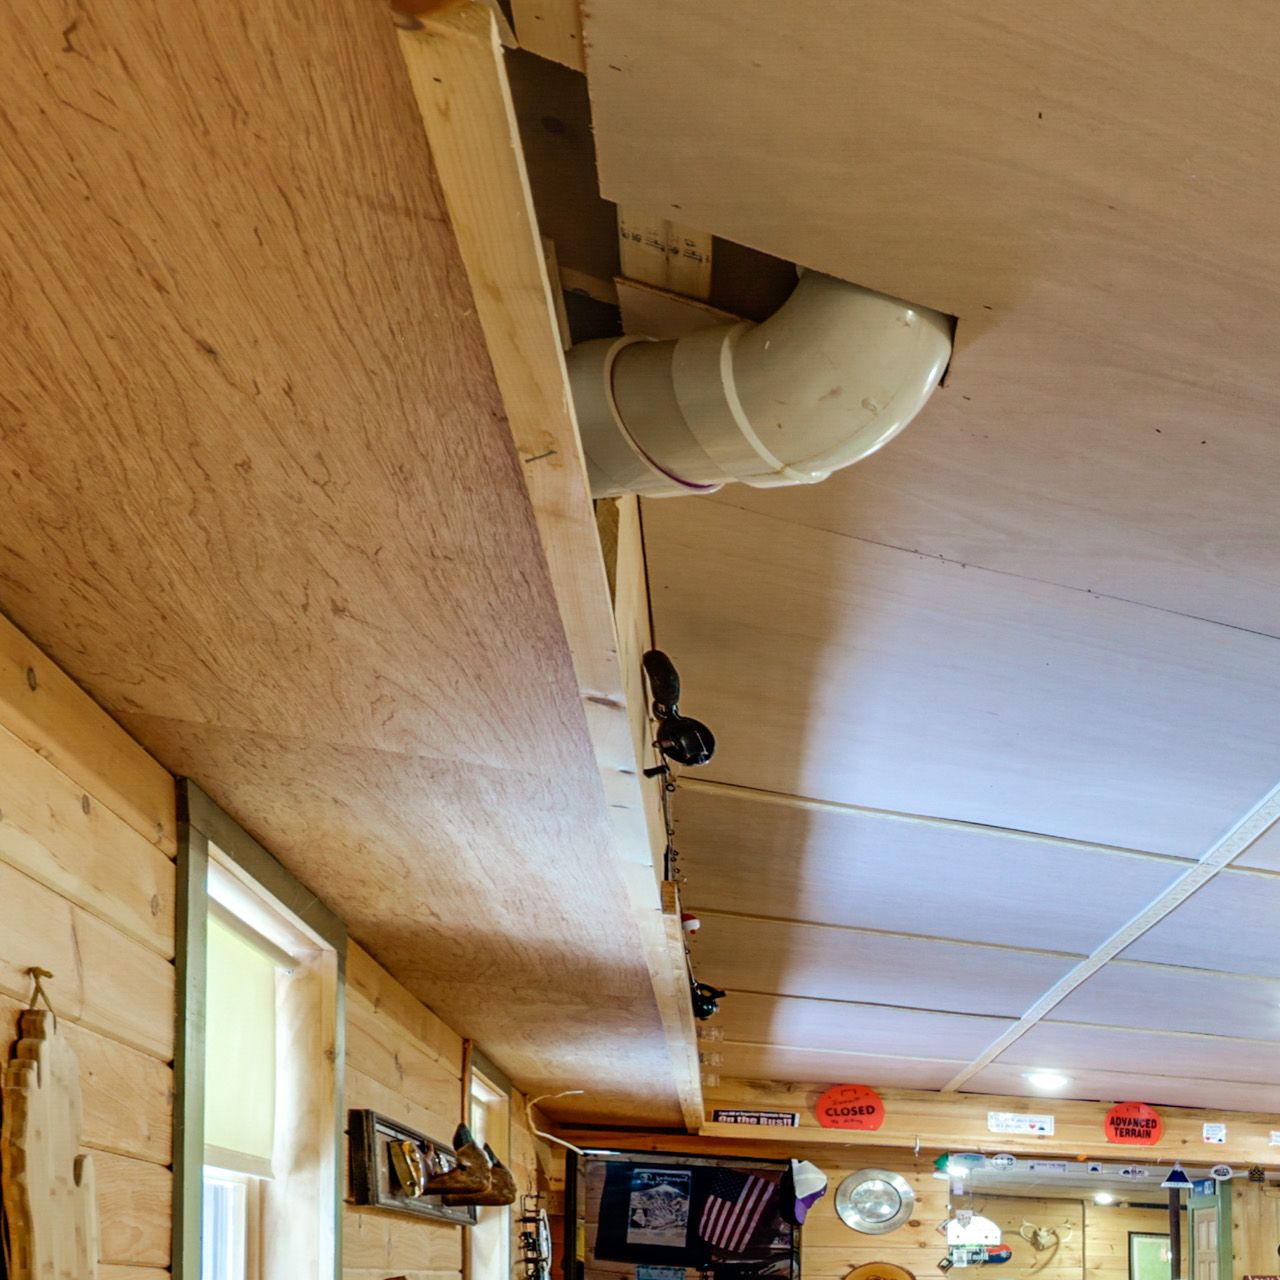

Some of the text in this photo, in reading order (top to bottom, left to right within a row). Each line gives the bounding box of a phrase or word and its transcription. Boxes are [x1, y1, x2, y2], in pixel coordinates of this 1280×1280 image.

[825, 1105, 876, 1117] CLOSED
[737, 1115, 757, 1125] the
[1110, 1116, 1158, 1129] ADVANCED
[1114, 1126, 1152, 1139] TERRAIN
